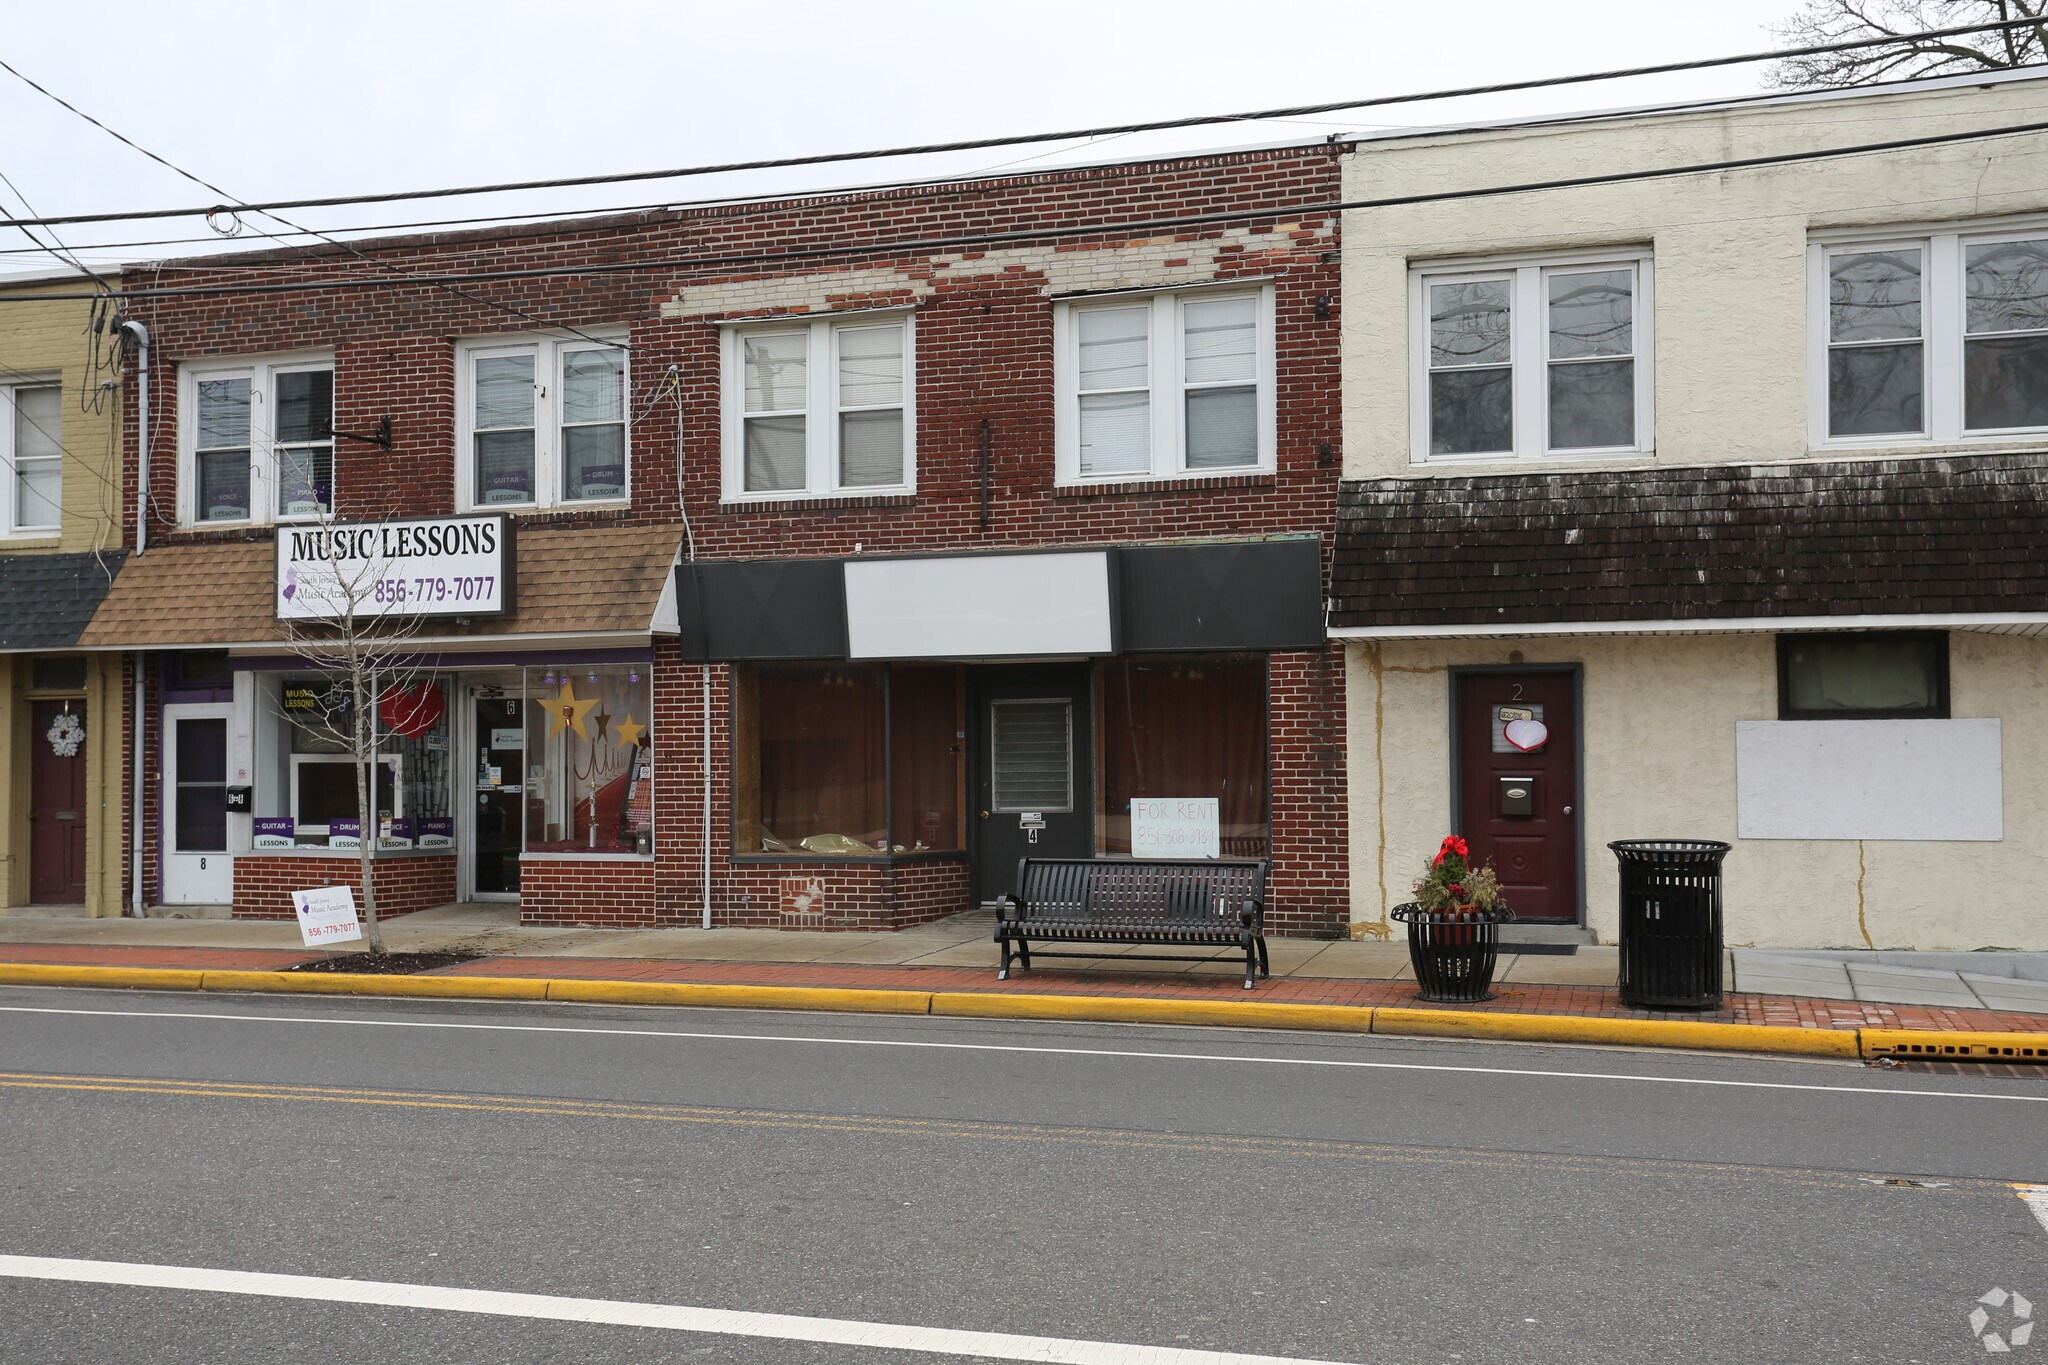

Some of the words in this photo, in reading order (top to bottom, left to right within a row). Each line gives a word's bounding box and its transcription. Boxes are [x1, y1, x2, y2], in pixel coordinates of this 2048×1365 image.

[493, 476, 520, 484] GUITAR
[491, 493, 522, 501] LESSONS
[588, 487, 619, 496] LESSONS
[290, 529, 373, 562] MUSIC
[382, 523, 496, 558] LESSONS
[298, 588, 326, 600] Music
[375, 576, 495, 603] 856-779-7077
[1512, 683, 1523, 701] 2
[285, 699, 315, 708] LESSONS
[508, 701, 514, 714] 6
[1138, 802, 1169, 820] FOR
[1177, 802, 1217, 820] RENT
[339, 823, 360, 831] DRUM
[1029, 829, 1036, 842] 4
[1137, 826, 1214, 846] 856-308-3939
[381, 840, 408, 848] LESSONS
[200, 857, 207, 870] 8
[326, 902, 349, 912] Academy
[307, 927, 322, 937] 856
